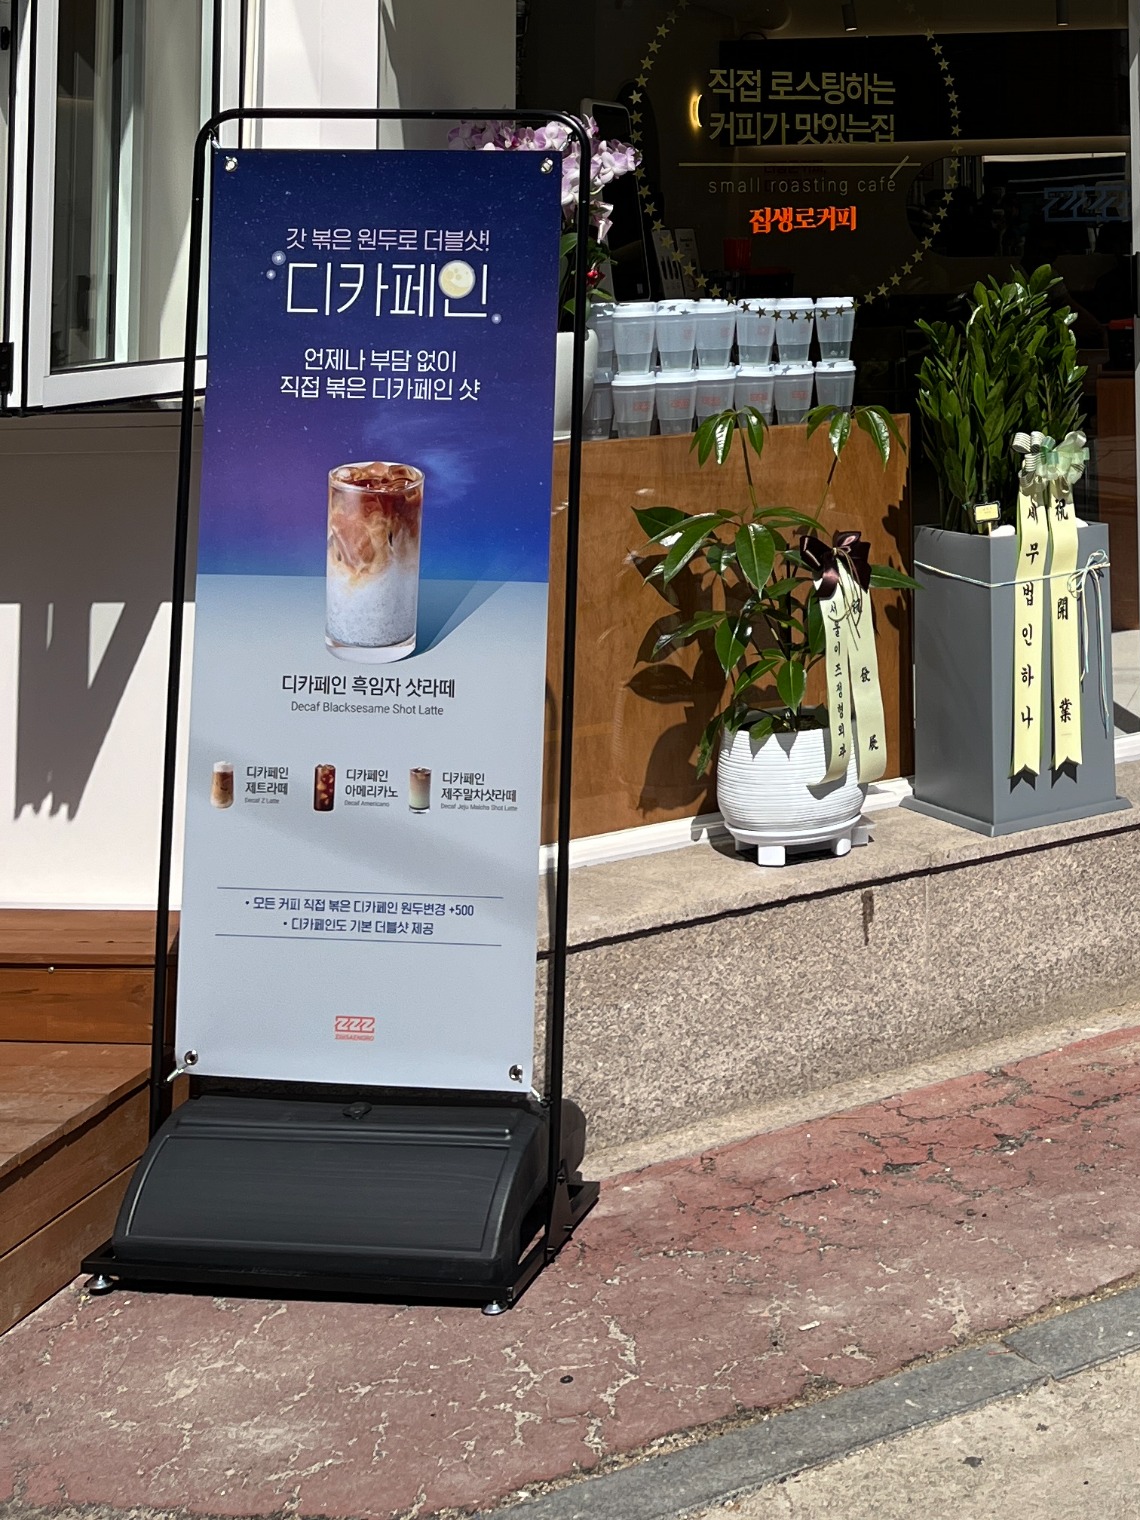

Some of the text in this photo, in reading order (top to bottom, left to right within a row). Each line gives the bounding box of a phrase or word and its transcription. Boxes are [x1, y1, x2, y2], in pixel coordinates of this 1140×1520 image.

[708, 69, 896, 105] 직접 로스팅하는
[709, 111, 895, 146] 커피가 맛있는집
[708, 177, 761, 194] small
[770, 177, 849, 197] roasting
[749, 205, 857, 234] 집생로커피
[286, 228, 490, 252] 갓 볶은 원두로 더블샷!
[286, 259, 488, 318] 디카페인
[304, 348, 457, 372] 언제나 부담 없이
[279, 375, 481, 401] 직접 볶은 디카페인 샷
[282, 675, 456, 699] 디카페인 흑임자 샷라떼
[291, 701, 445, 716] Decaf Blacksesame Shot Latte
[246, 766, 289, 780] 디카페인
[346, 768, 389, 783] 디카페인
[442, 772, 485, 786] 디카페인
[244, 781, 289, 795] 제트라떼
[345, 784, 399, 798] 아메리카노
[441, 787, 517, 802] 제주말차샷라떼
[253, 896, 475, 917] 모든 커피 직접 볶은 디카페인 원두변경 +500
[291, 917, 434, 935] 디카페인도 기본 더블샷 제공
